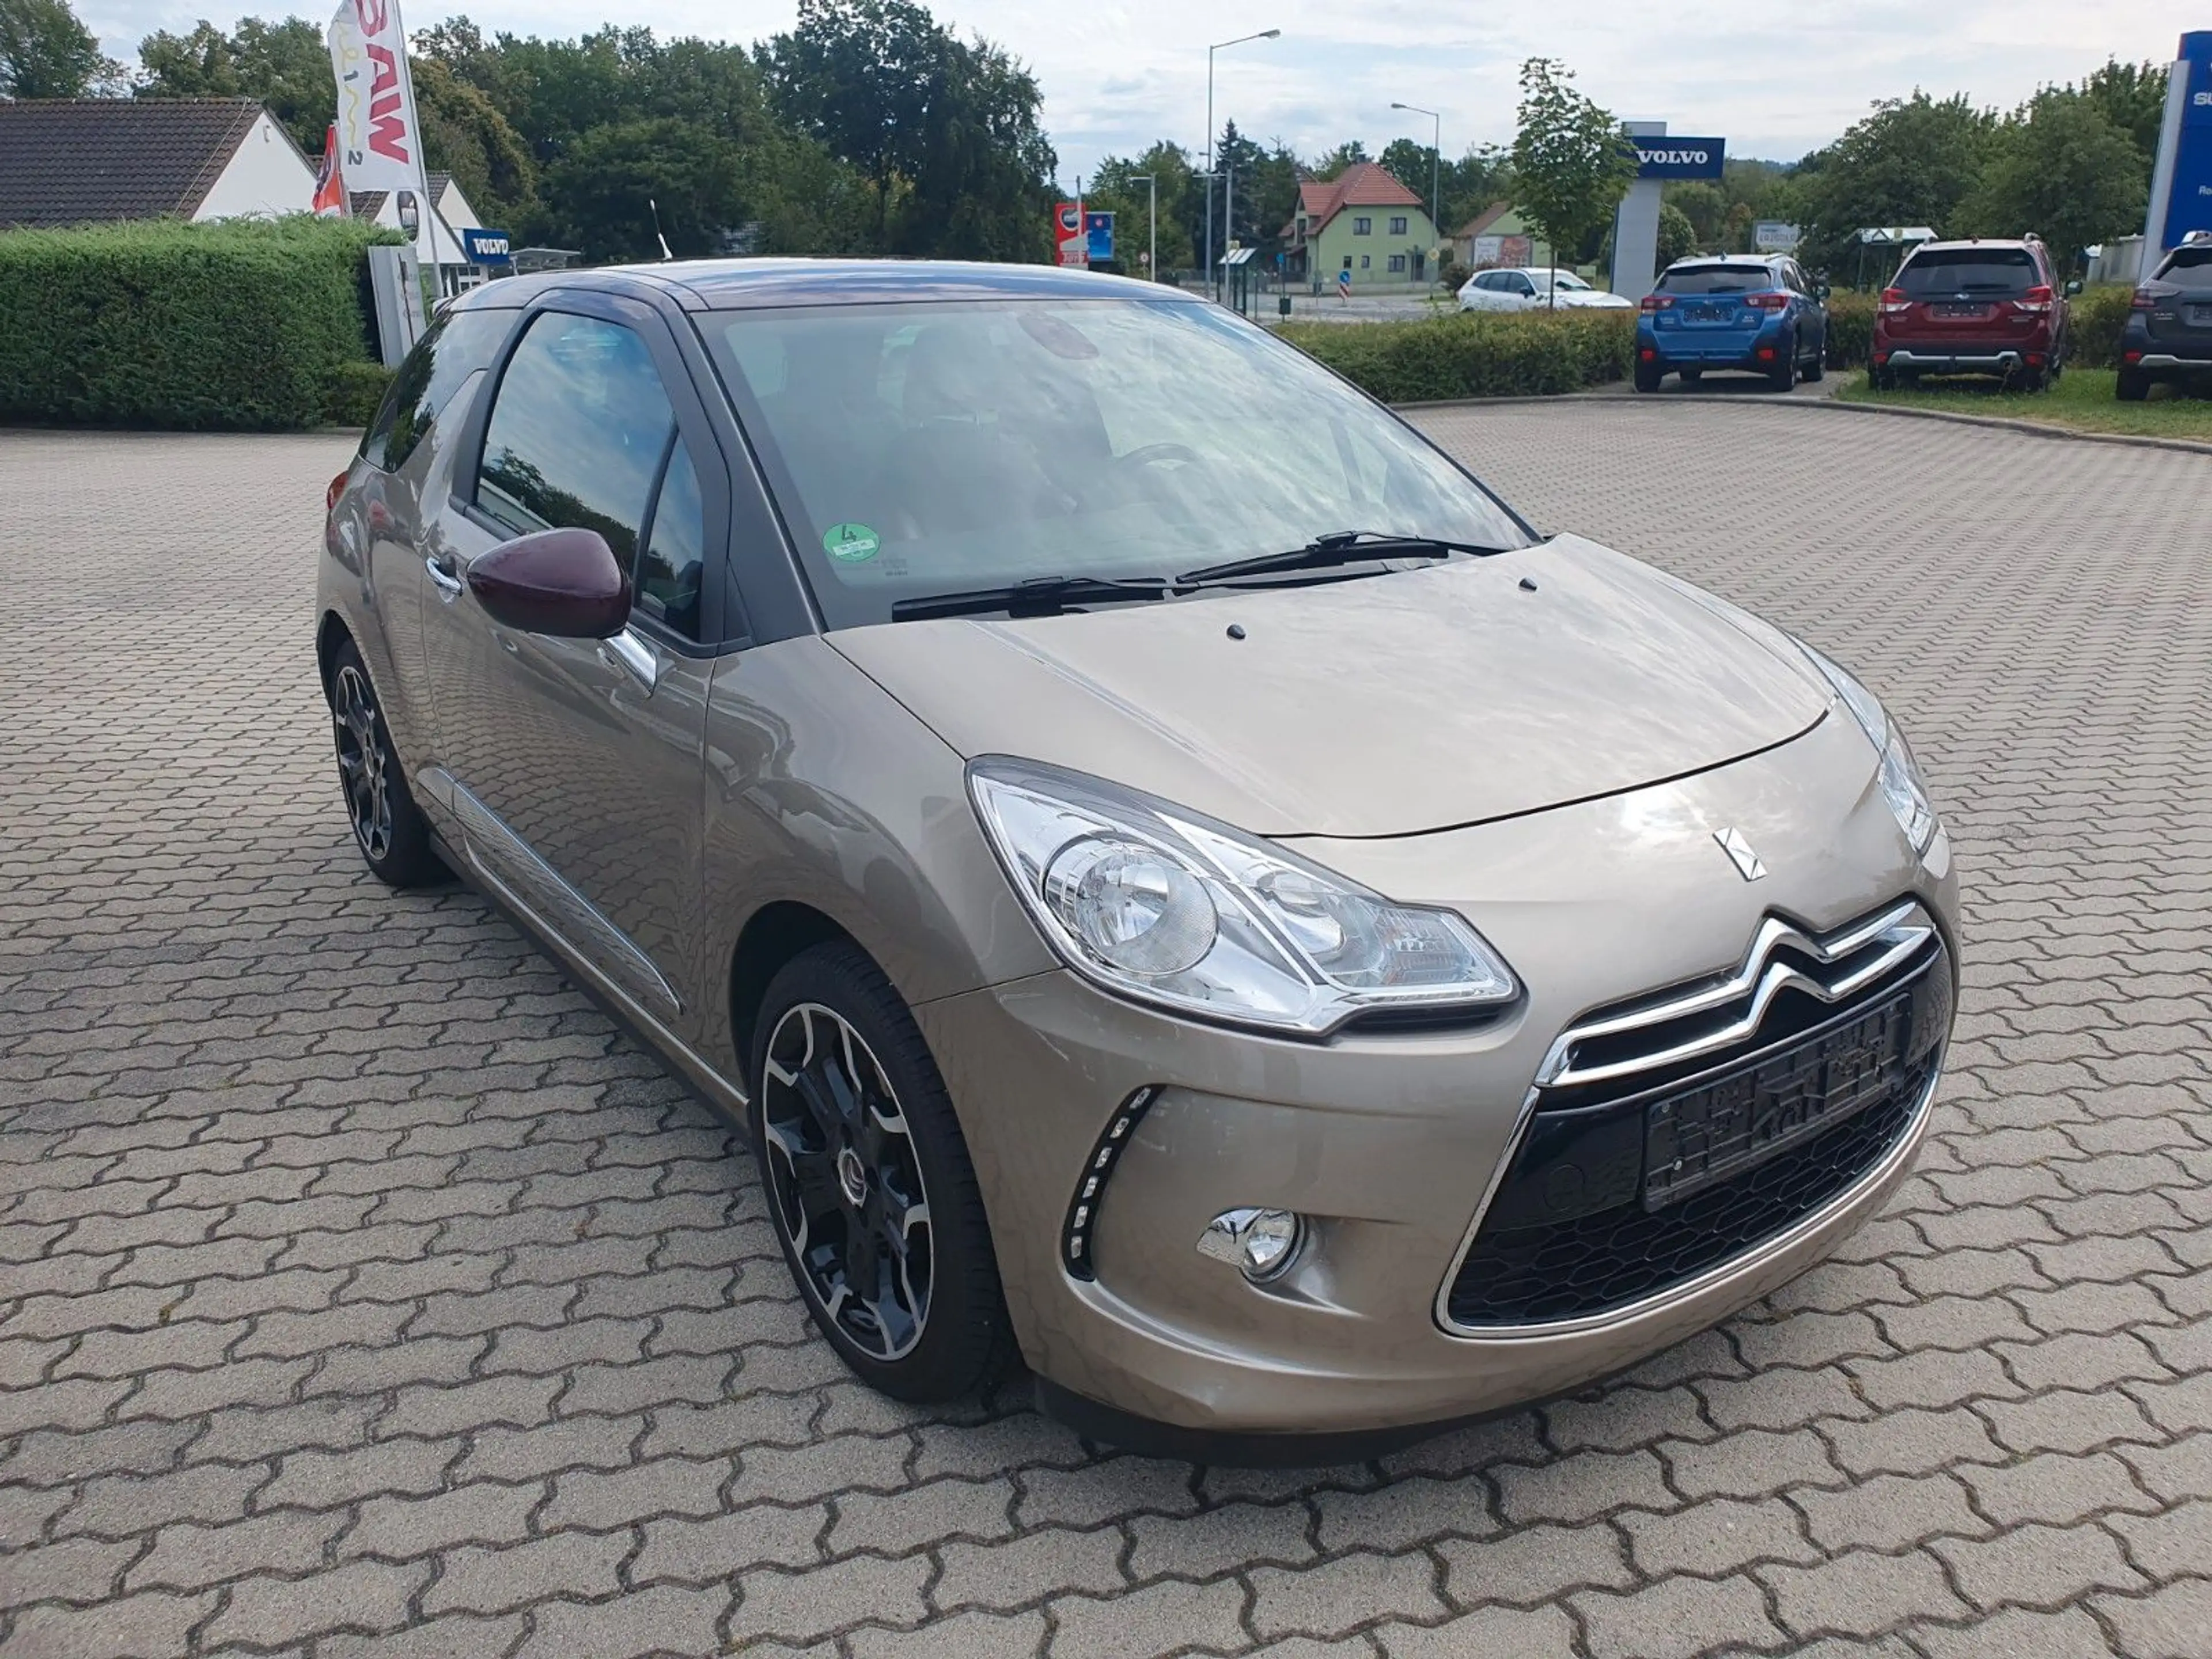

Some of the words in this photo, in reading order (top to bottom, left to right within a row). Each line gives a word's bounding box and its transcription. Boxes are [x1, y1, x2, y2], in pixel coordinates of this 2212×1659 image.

[348, 150, 363, 166] 2
[1635, 150, 1709, 165] VOLVO
[473, 238, 509, 255] VOLVO
[841, 524, 857, 541] 4
